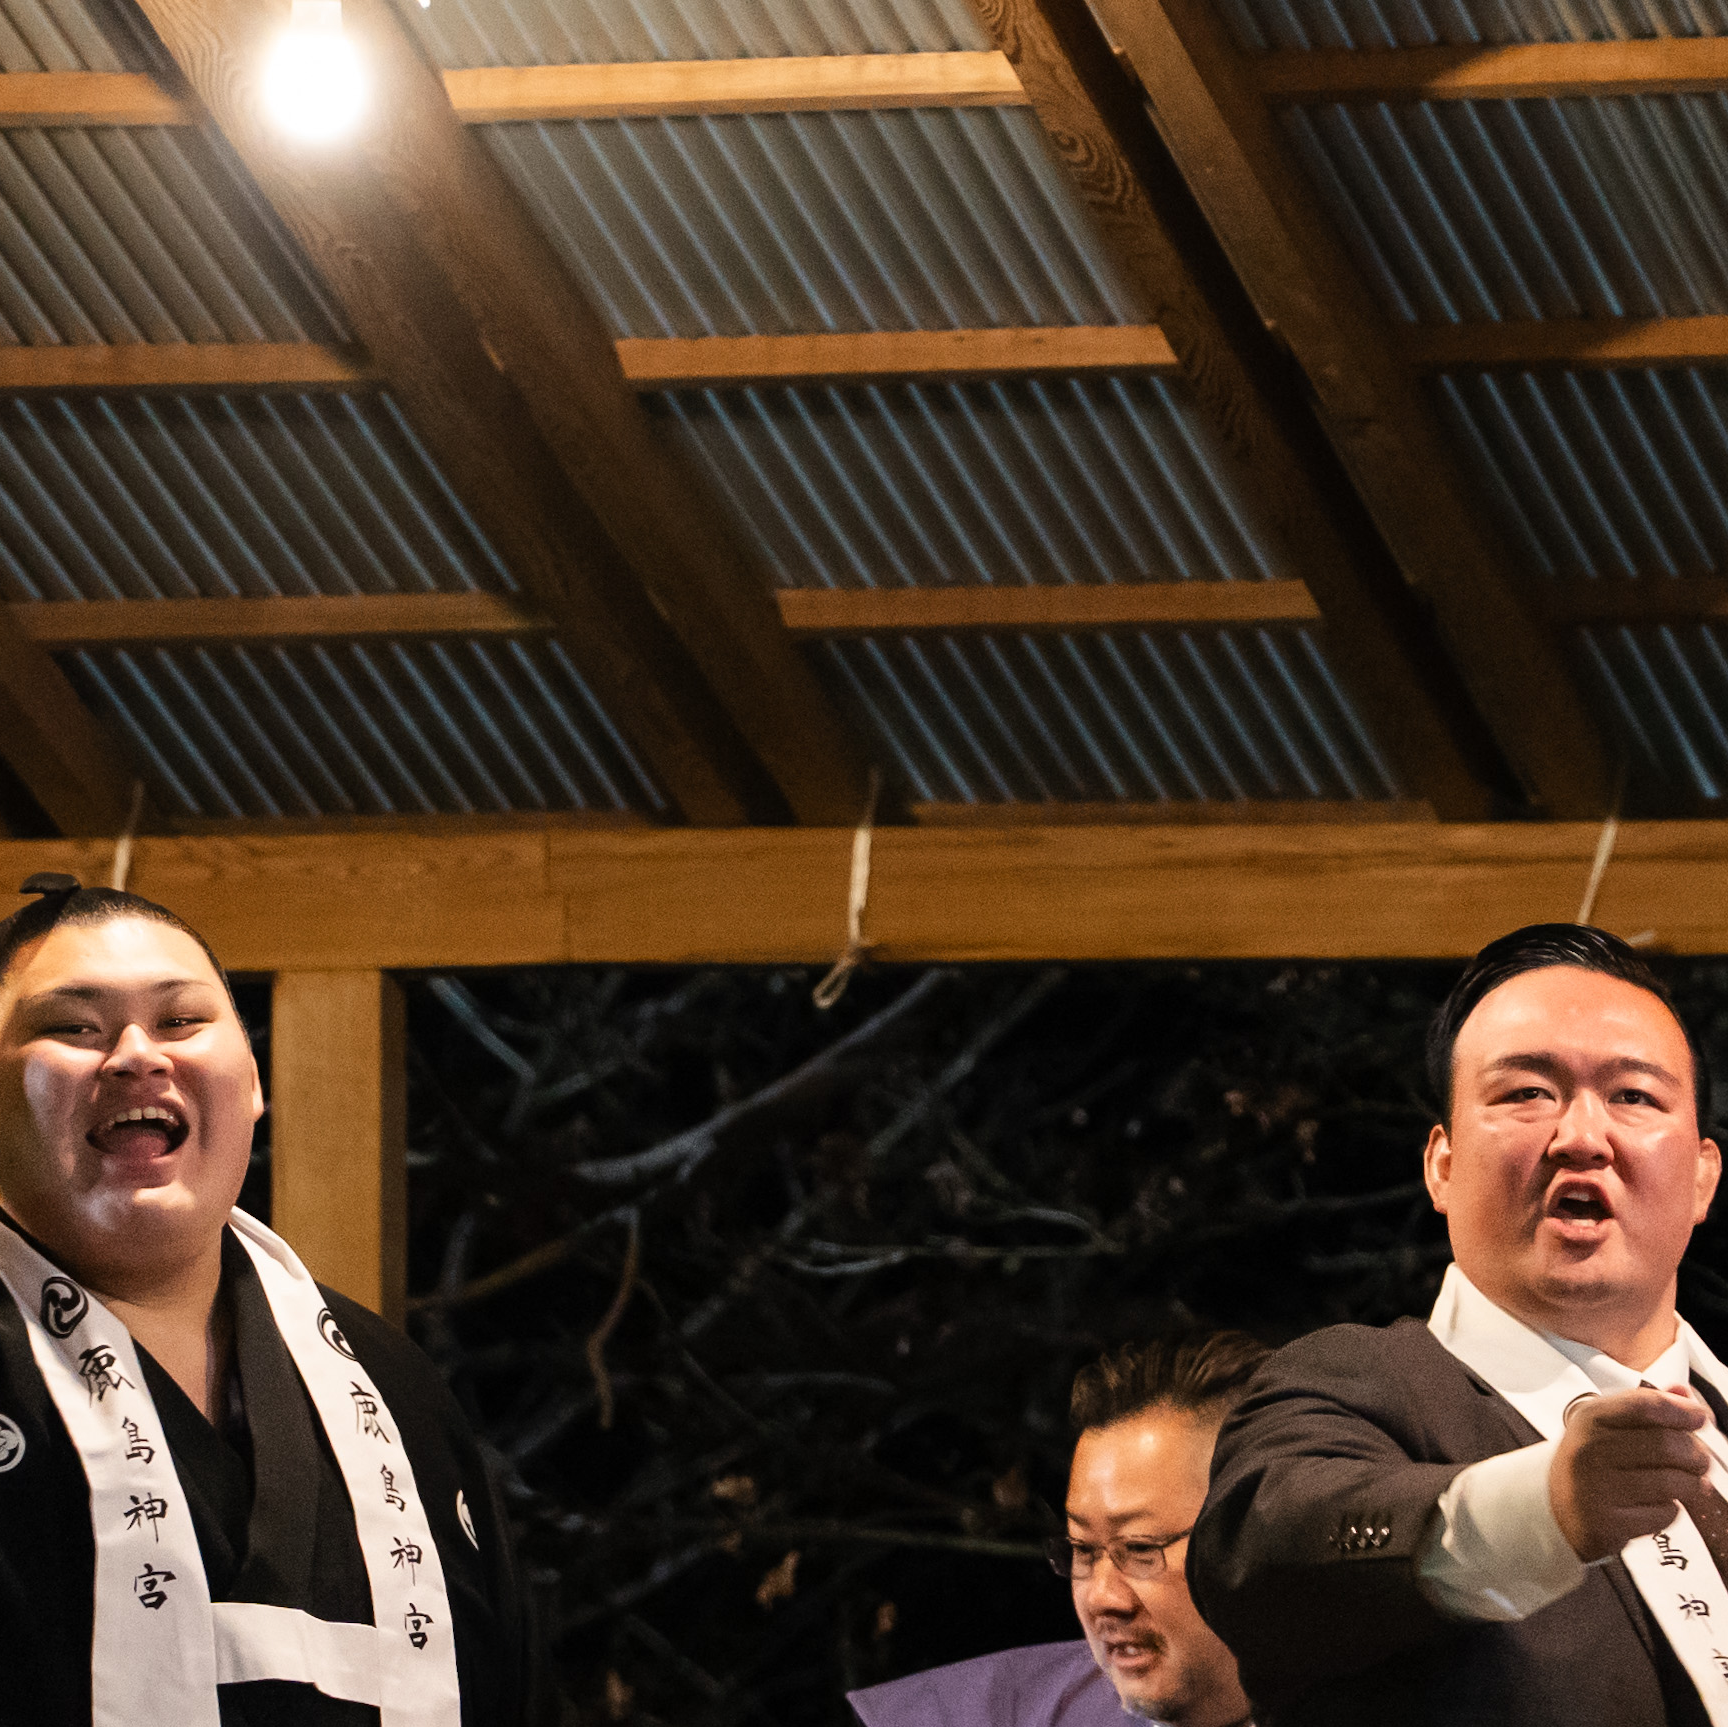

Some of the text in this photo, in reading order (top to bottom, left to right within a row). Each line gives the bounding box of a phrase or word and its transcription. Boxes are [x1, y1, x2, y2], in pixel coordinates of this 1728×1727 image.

[78, 1344, 176, 1610] 鹿島神宮
[350, 1380, 433, 1650] 鹿島神宮
